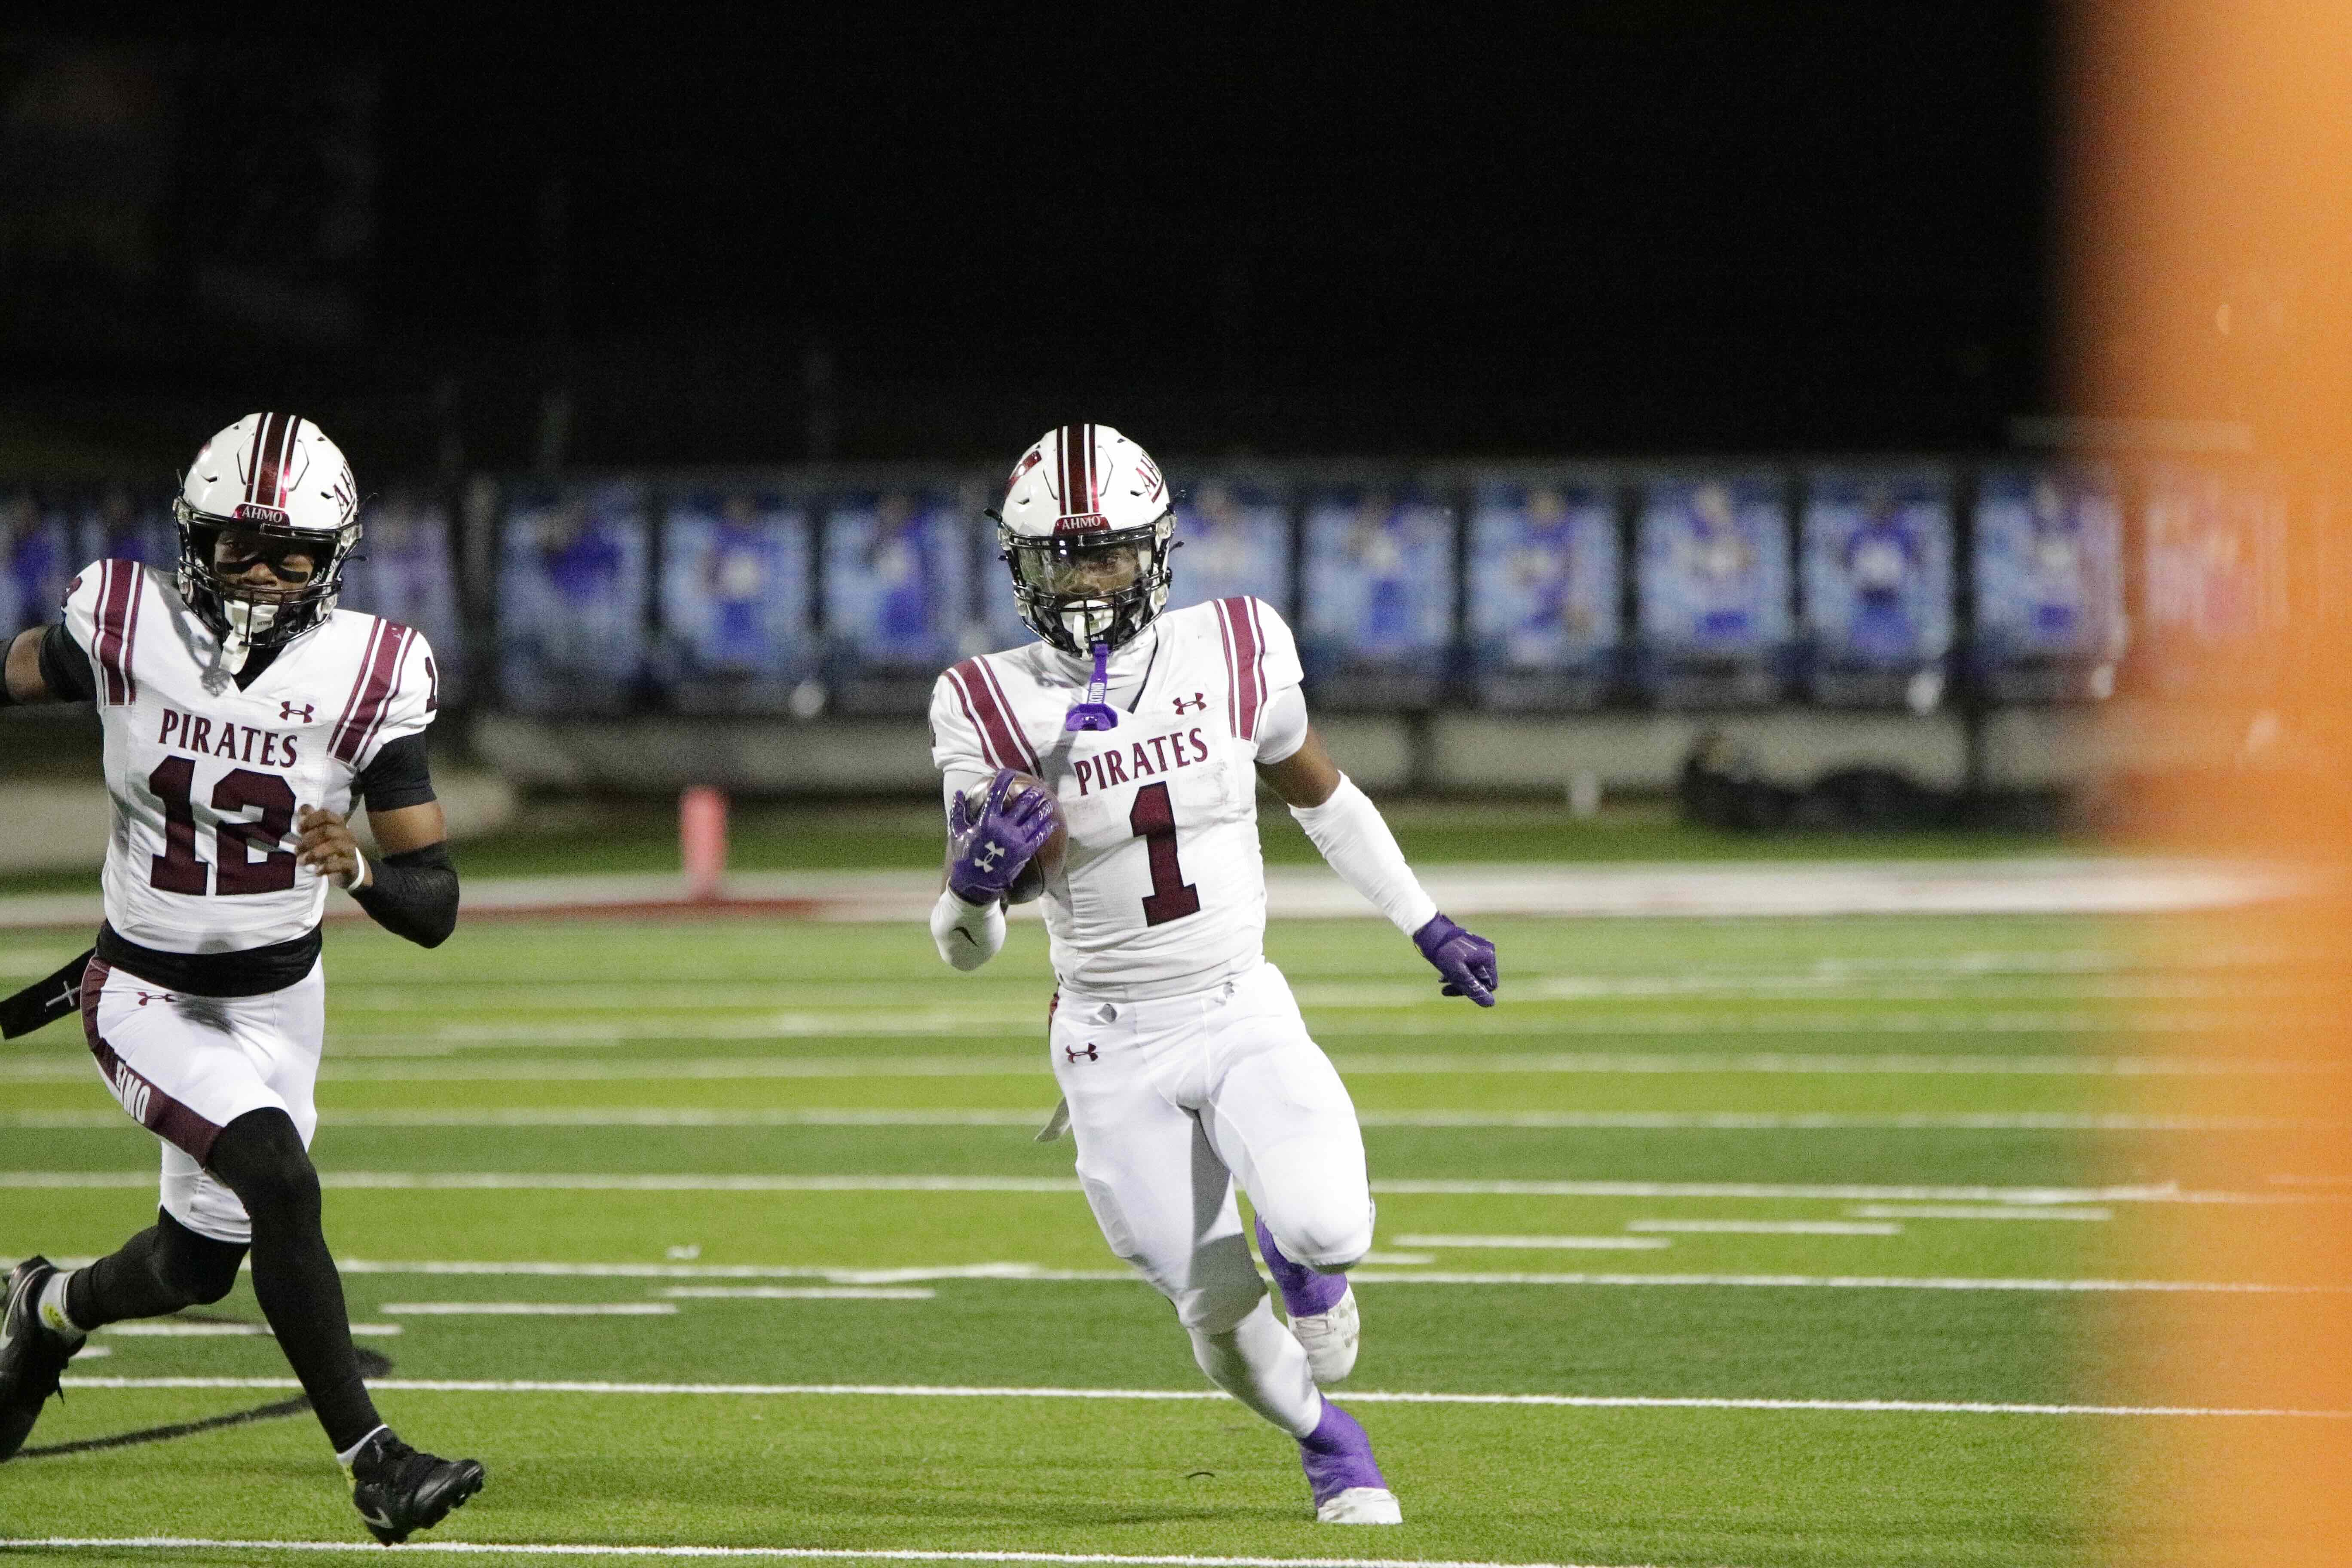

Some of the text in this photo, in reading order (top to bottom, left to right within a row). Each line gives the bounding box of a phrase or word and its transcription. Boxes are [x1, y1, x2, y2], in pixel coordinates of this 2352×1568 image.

[242, 506, 283, 523] AHMO
[1062, 516, 1101, 530] AHMO
[157, 708, 298, 768] PIRATES
[1074, 728, 1208, 796] PIRATES
[149, 755, 297, 896] 12
[1130, 781, 1200, 927] 1
